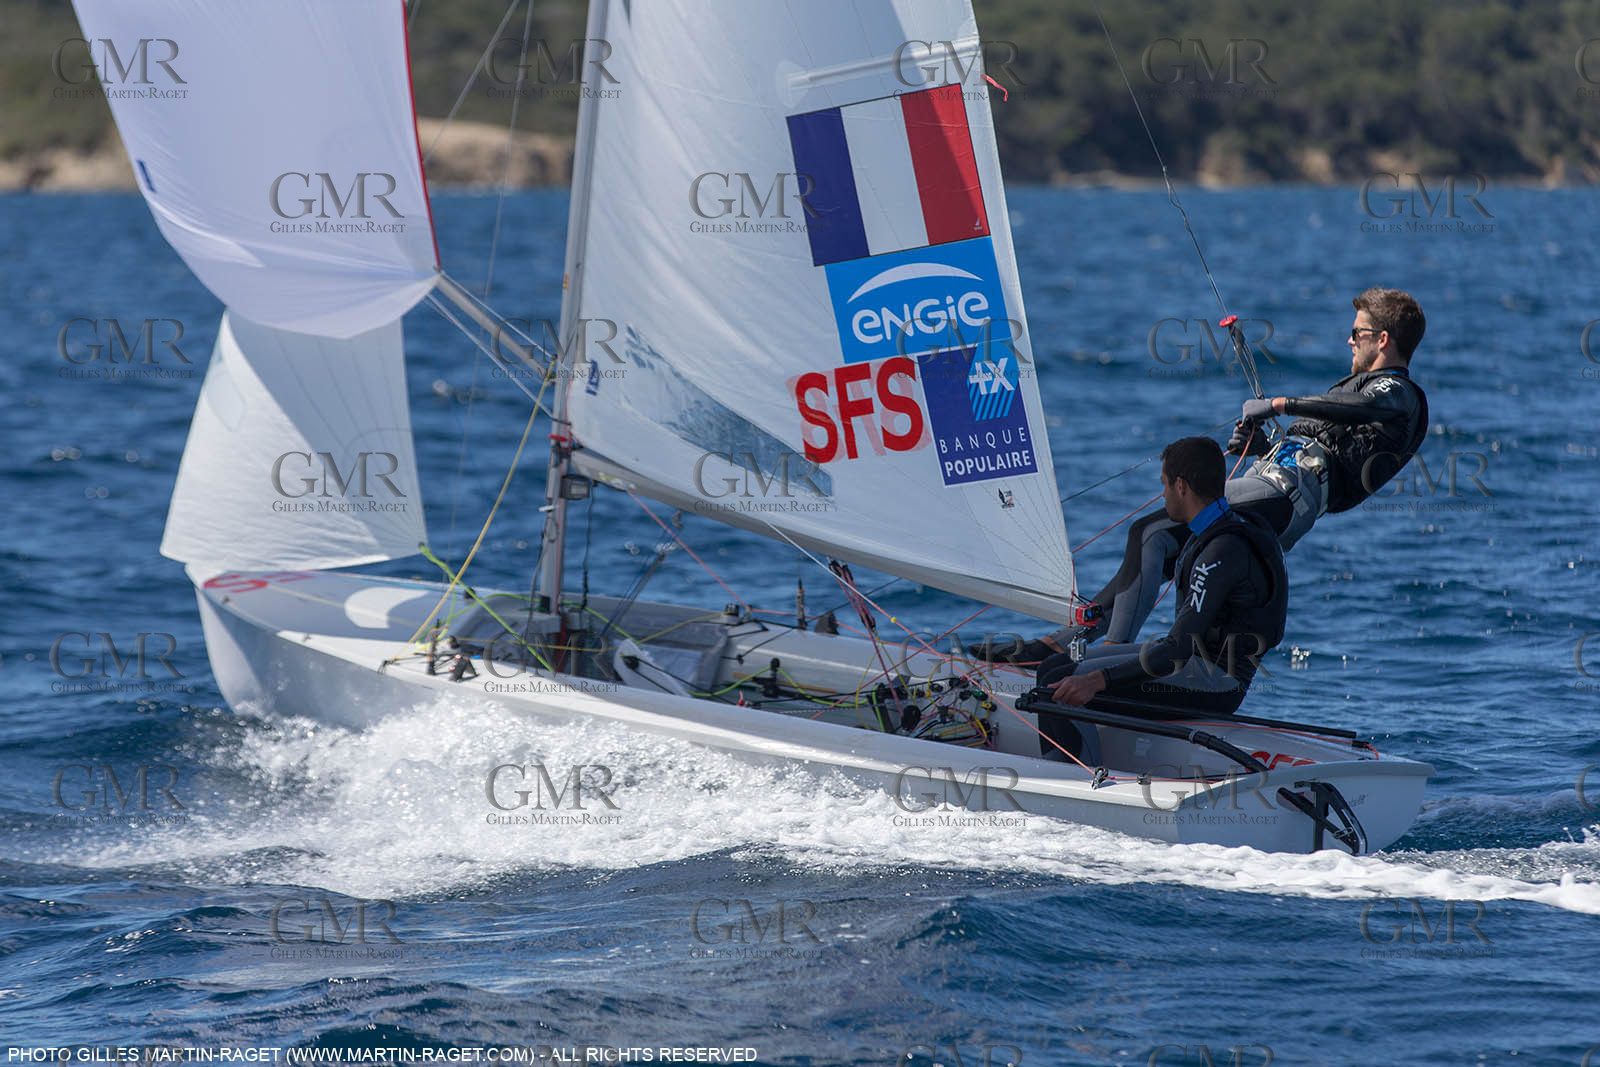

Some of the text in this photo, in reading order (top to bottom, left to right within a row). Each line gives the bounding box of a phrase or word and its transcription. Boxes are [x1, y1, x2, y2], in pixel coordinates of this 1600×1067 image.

[795, 356, 924, 464] SFS
[940, 426, 1028, 454] BANQUE
[944, 449, 1032, 477] POPULAIRE
